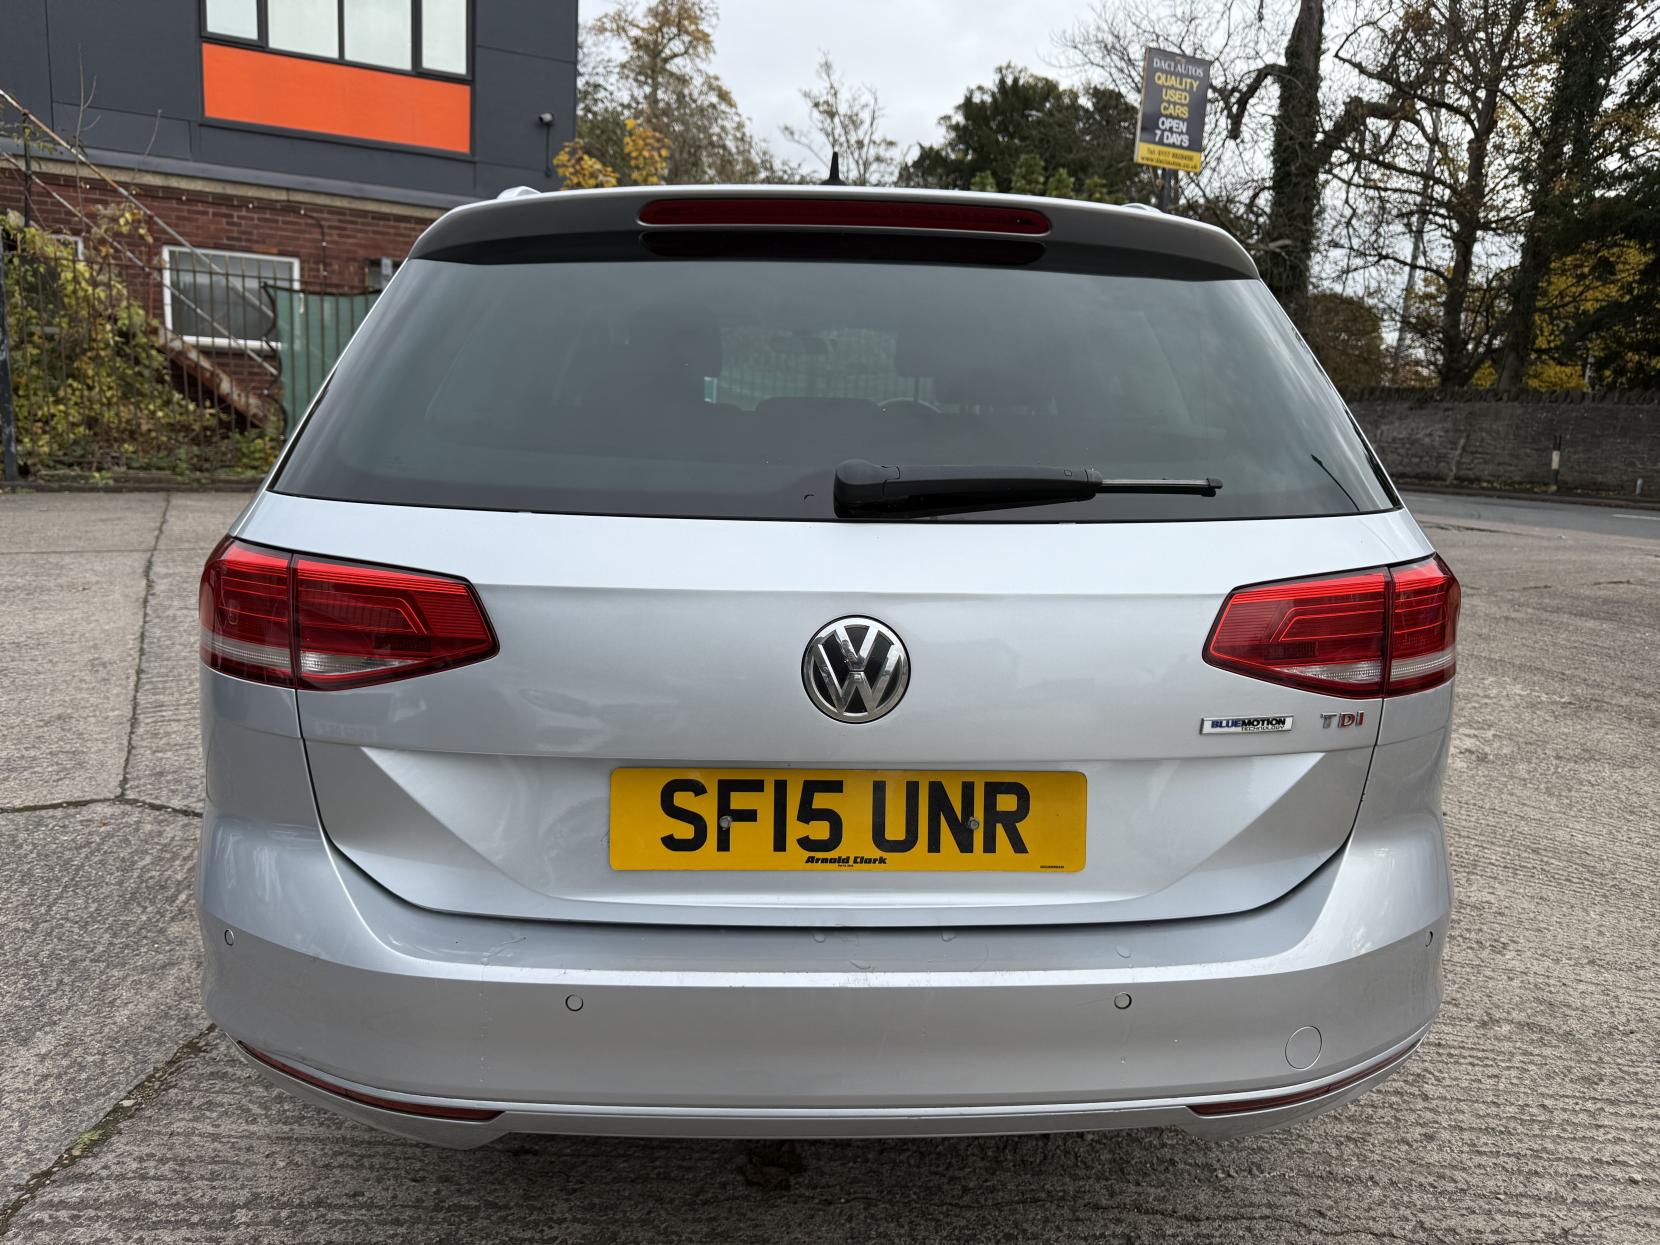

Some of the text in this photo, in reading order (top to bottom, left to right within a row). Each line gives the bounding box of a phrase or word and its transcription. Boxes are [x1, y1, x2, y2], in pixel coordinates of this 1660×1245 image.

[1153, 58, 1204, 78] DACI AUTOS
[1155, 72, 1199, 92] QUALITY
[1162, 88, 1189, 104] USED
[1160, 103, 1189, 119] CARS
[1158, 117, 1187, 133] OPEN
[1154, 130, 1190, 148] 7 DAYS
[1210, 718, 1286, 729] BLUEMOTION
[1321, 711, 1365, 729] TDI
[660, 778, 1031, 854] SF15 UNR
[805, 855, 888, 864] Arnold Clark
